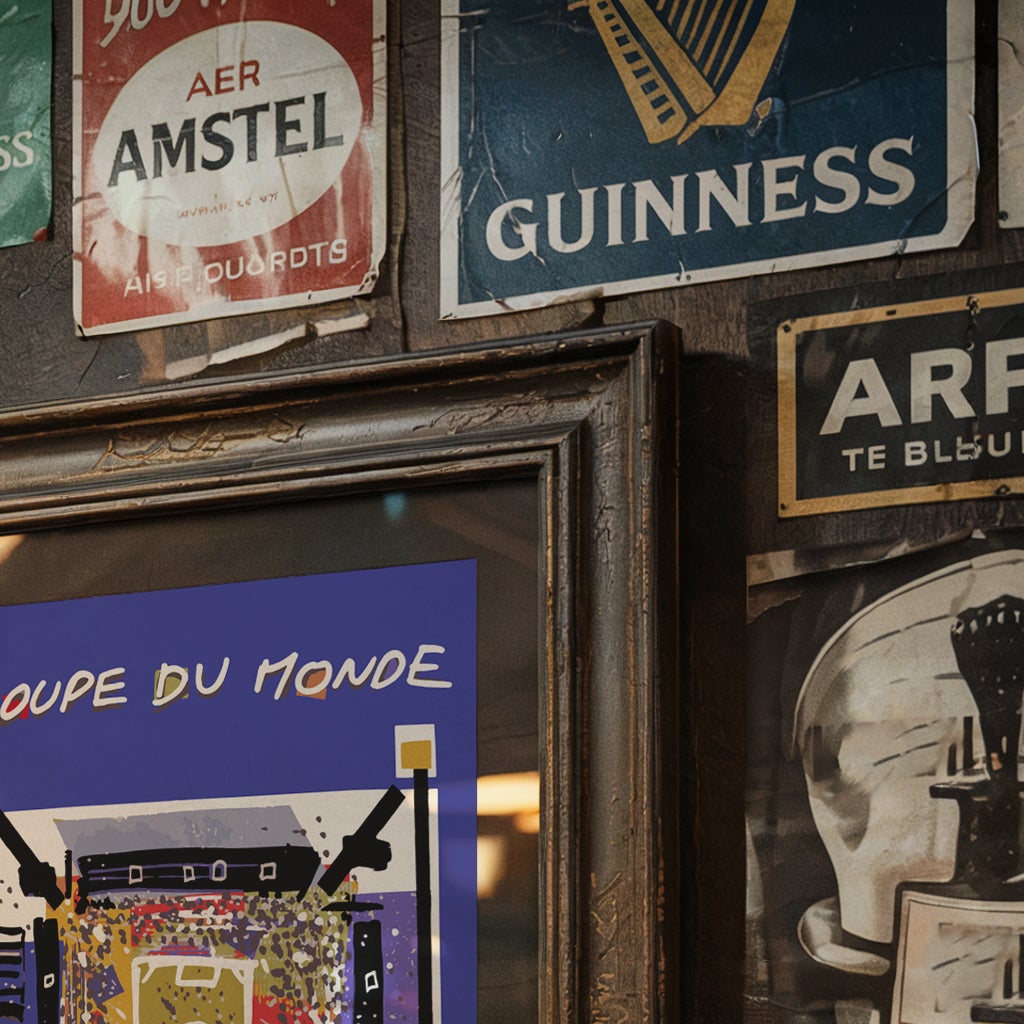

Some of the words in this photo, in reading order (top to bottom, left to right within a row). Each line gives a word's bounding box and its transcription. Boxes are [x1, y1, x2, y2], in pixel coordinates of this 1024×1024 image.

[186, 60, 260, 102] AER
[107, 91, 345, 188] AMSTEL
[485, 136, 916, 262] GUINNESS
[842, 445, 887, 472] TE
[152, 657, 230, 706] DU
[255, 644, 453, 701] MONDE
